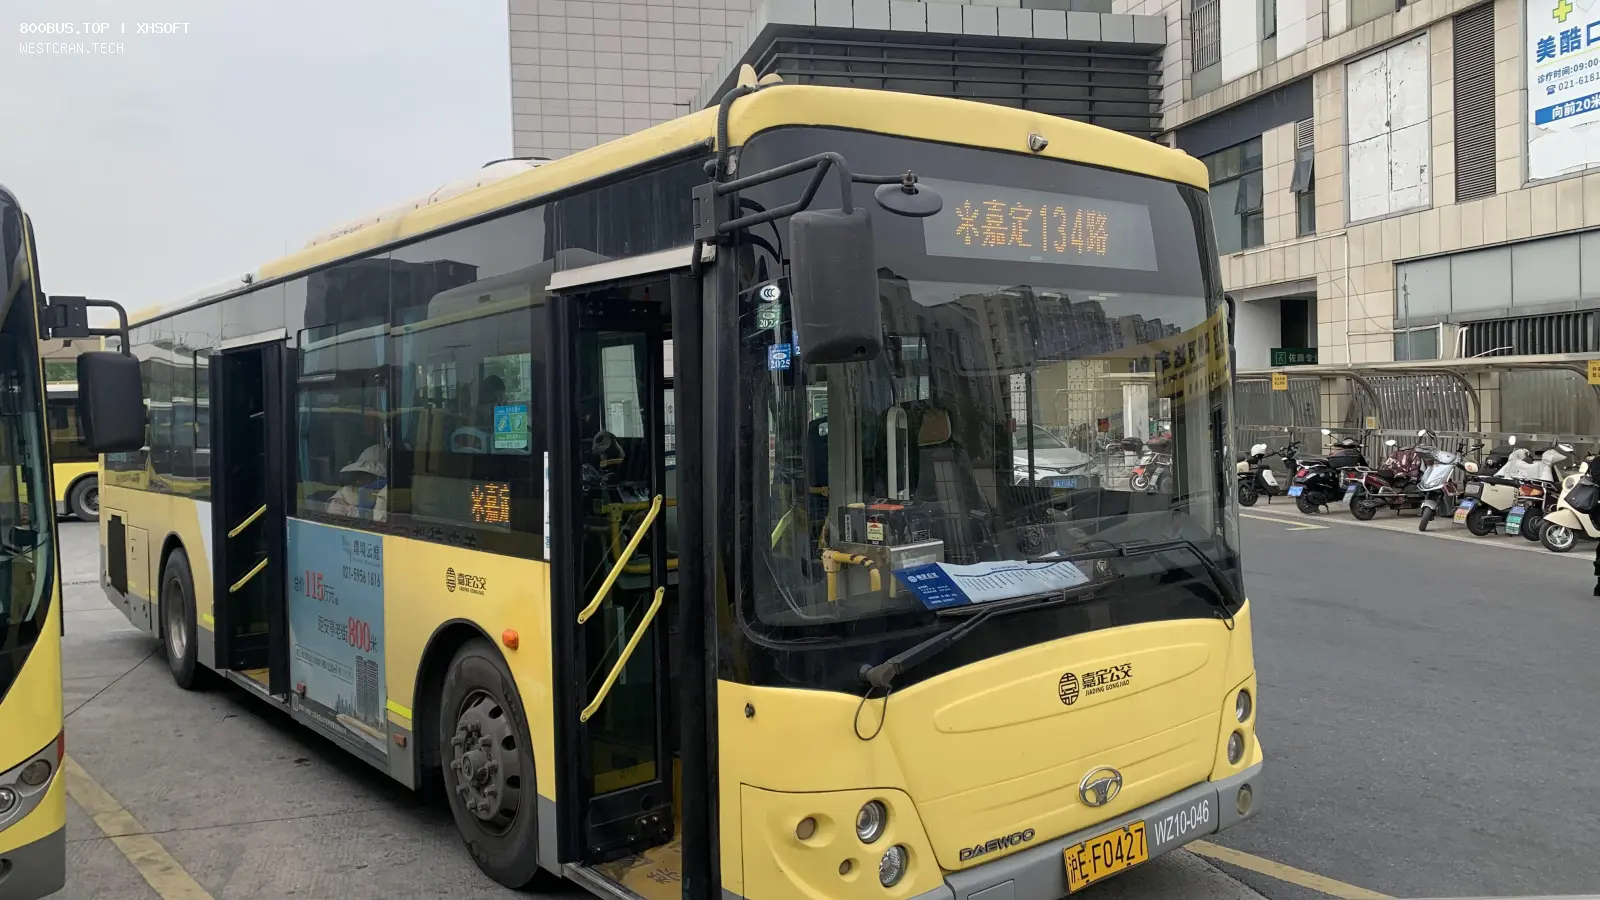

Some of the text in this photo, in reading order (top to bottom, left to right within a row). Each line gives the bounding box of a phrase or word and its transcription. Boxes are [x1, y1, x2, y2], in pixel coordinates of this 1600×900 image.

[1536, 20, 1600, 63] 美酷口
[1552, 94, 1600, 120] 向前20米
[770, 359, 791, 369] 2025
[1081, 662, 1133, 690] 嘉定公交
[1085, 679, 1130, 697] JIADING GONGJIAO
[1154, 800, 1210, 846] WZ10-046
[959, 827, 1036, 861] DAEWOO
